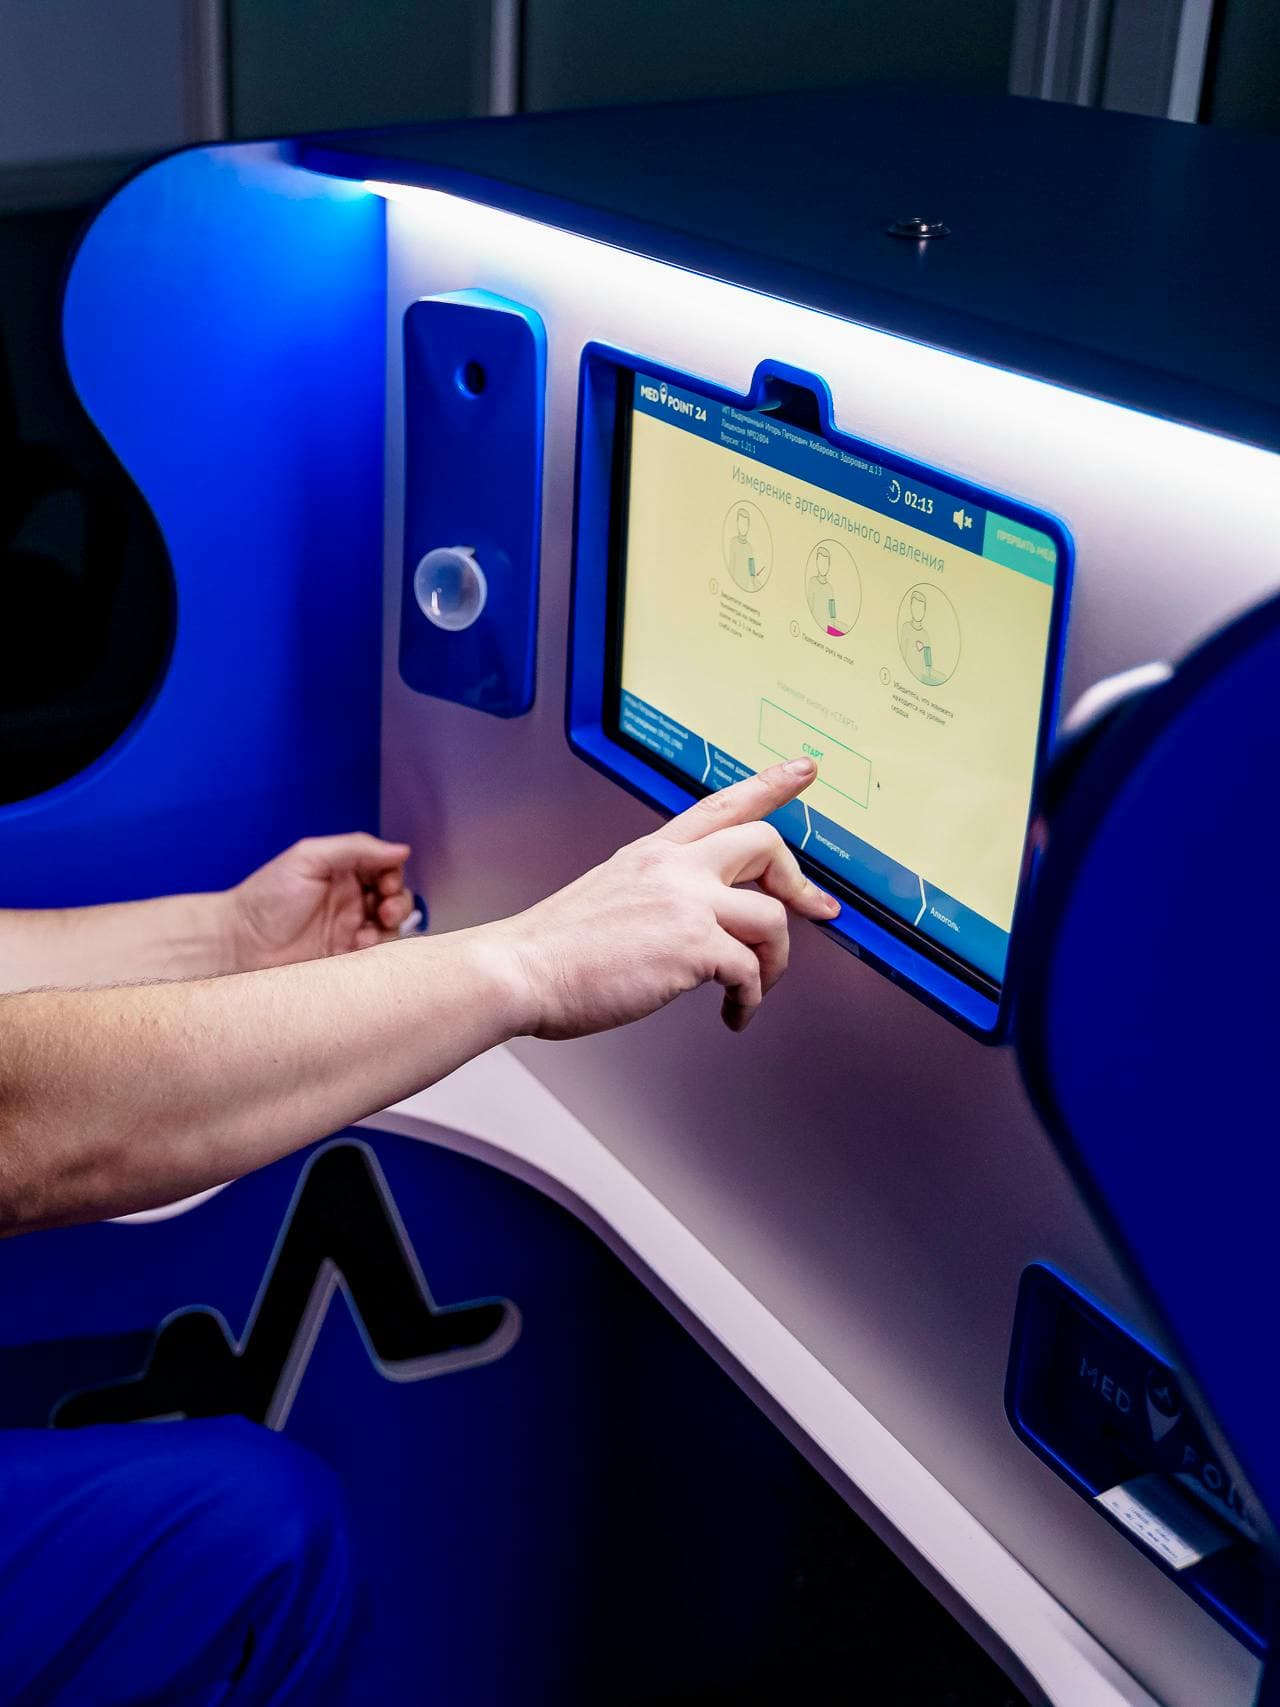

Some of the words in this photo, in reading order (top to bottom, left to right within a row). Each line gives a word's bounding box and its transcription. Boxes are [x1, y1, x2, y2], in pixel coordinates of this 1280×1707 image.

[639, 385, 660, 403] MED
[667, 395, 694, 417] POINT
[694, 405, 708, 423] 24
[904, 490, 934, 515] 02:13
[732, 465, 792, 506] Измерение
[795, 496, 881, 545] артериального
[883, 534, 945, 574] давления
[802, 743, 824, 761] СТАРТ
[930, 906, 961, 933] Алкоголь:
[1078, 1356, 1133, 1414] MED
